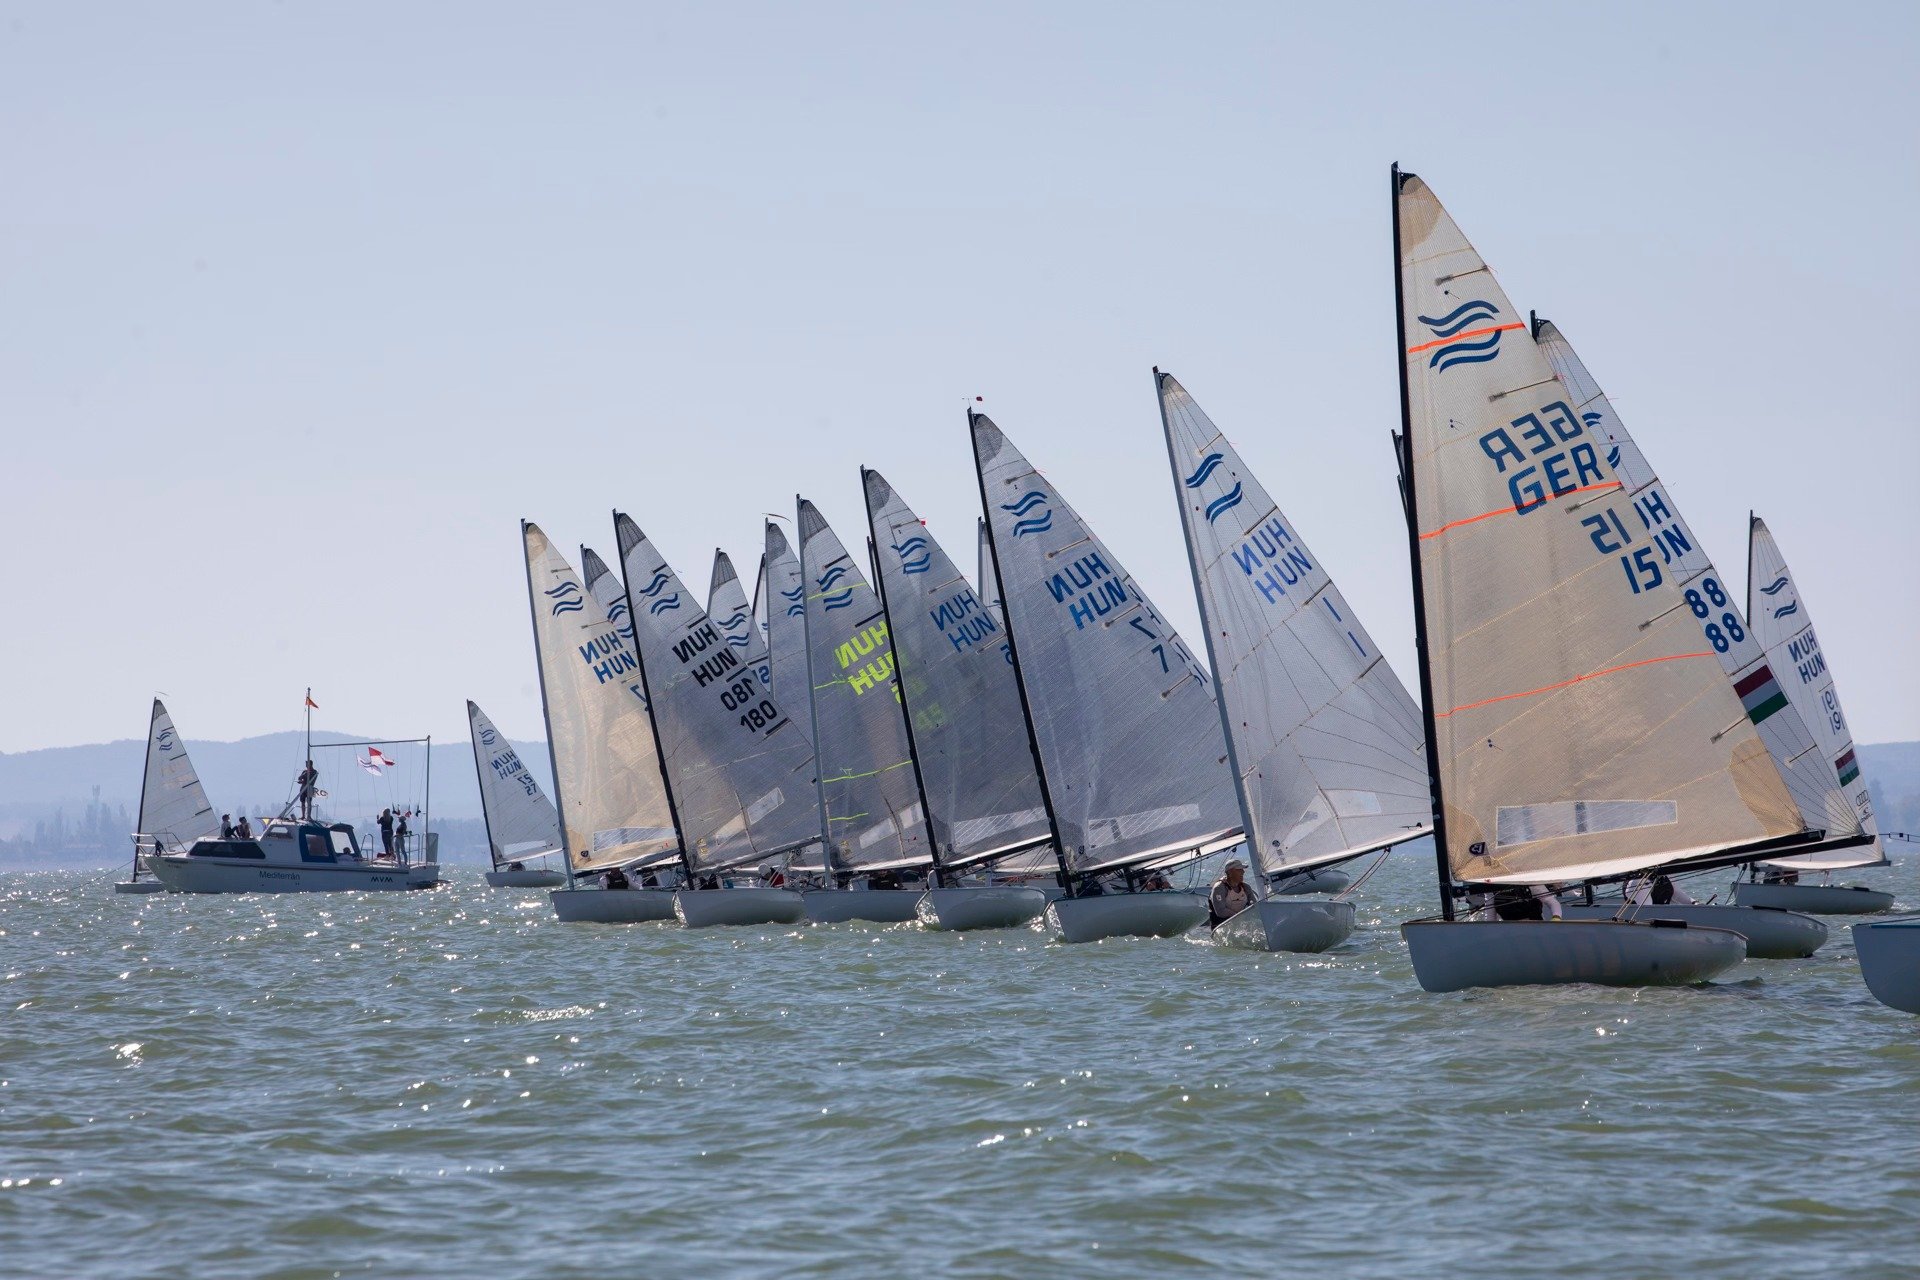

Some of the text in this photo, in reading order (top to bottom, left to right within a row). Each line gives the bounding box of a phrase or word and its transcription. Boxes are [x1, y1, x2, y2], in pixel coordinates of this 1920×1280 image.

[1508, 442, 1604, 516] GER
[1254, 546, 1312, 605] HUN
[1620, 547, 1663, 595] 15
[1068, 576, 1128, 631] HUN
[947, 612, 996, 653] HUN
[1705, 612, 1745, 654] 88
[593, 651, 638, 685] HUN
[691, 647, 738, 688] HUN
[1151, 644, 1169, 674] 7
[1798, 652, 1826, 685] HUN
[740, 700, 777, 733] 180
[498, 760, 522, 780] HUN
